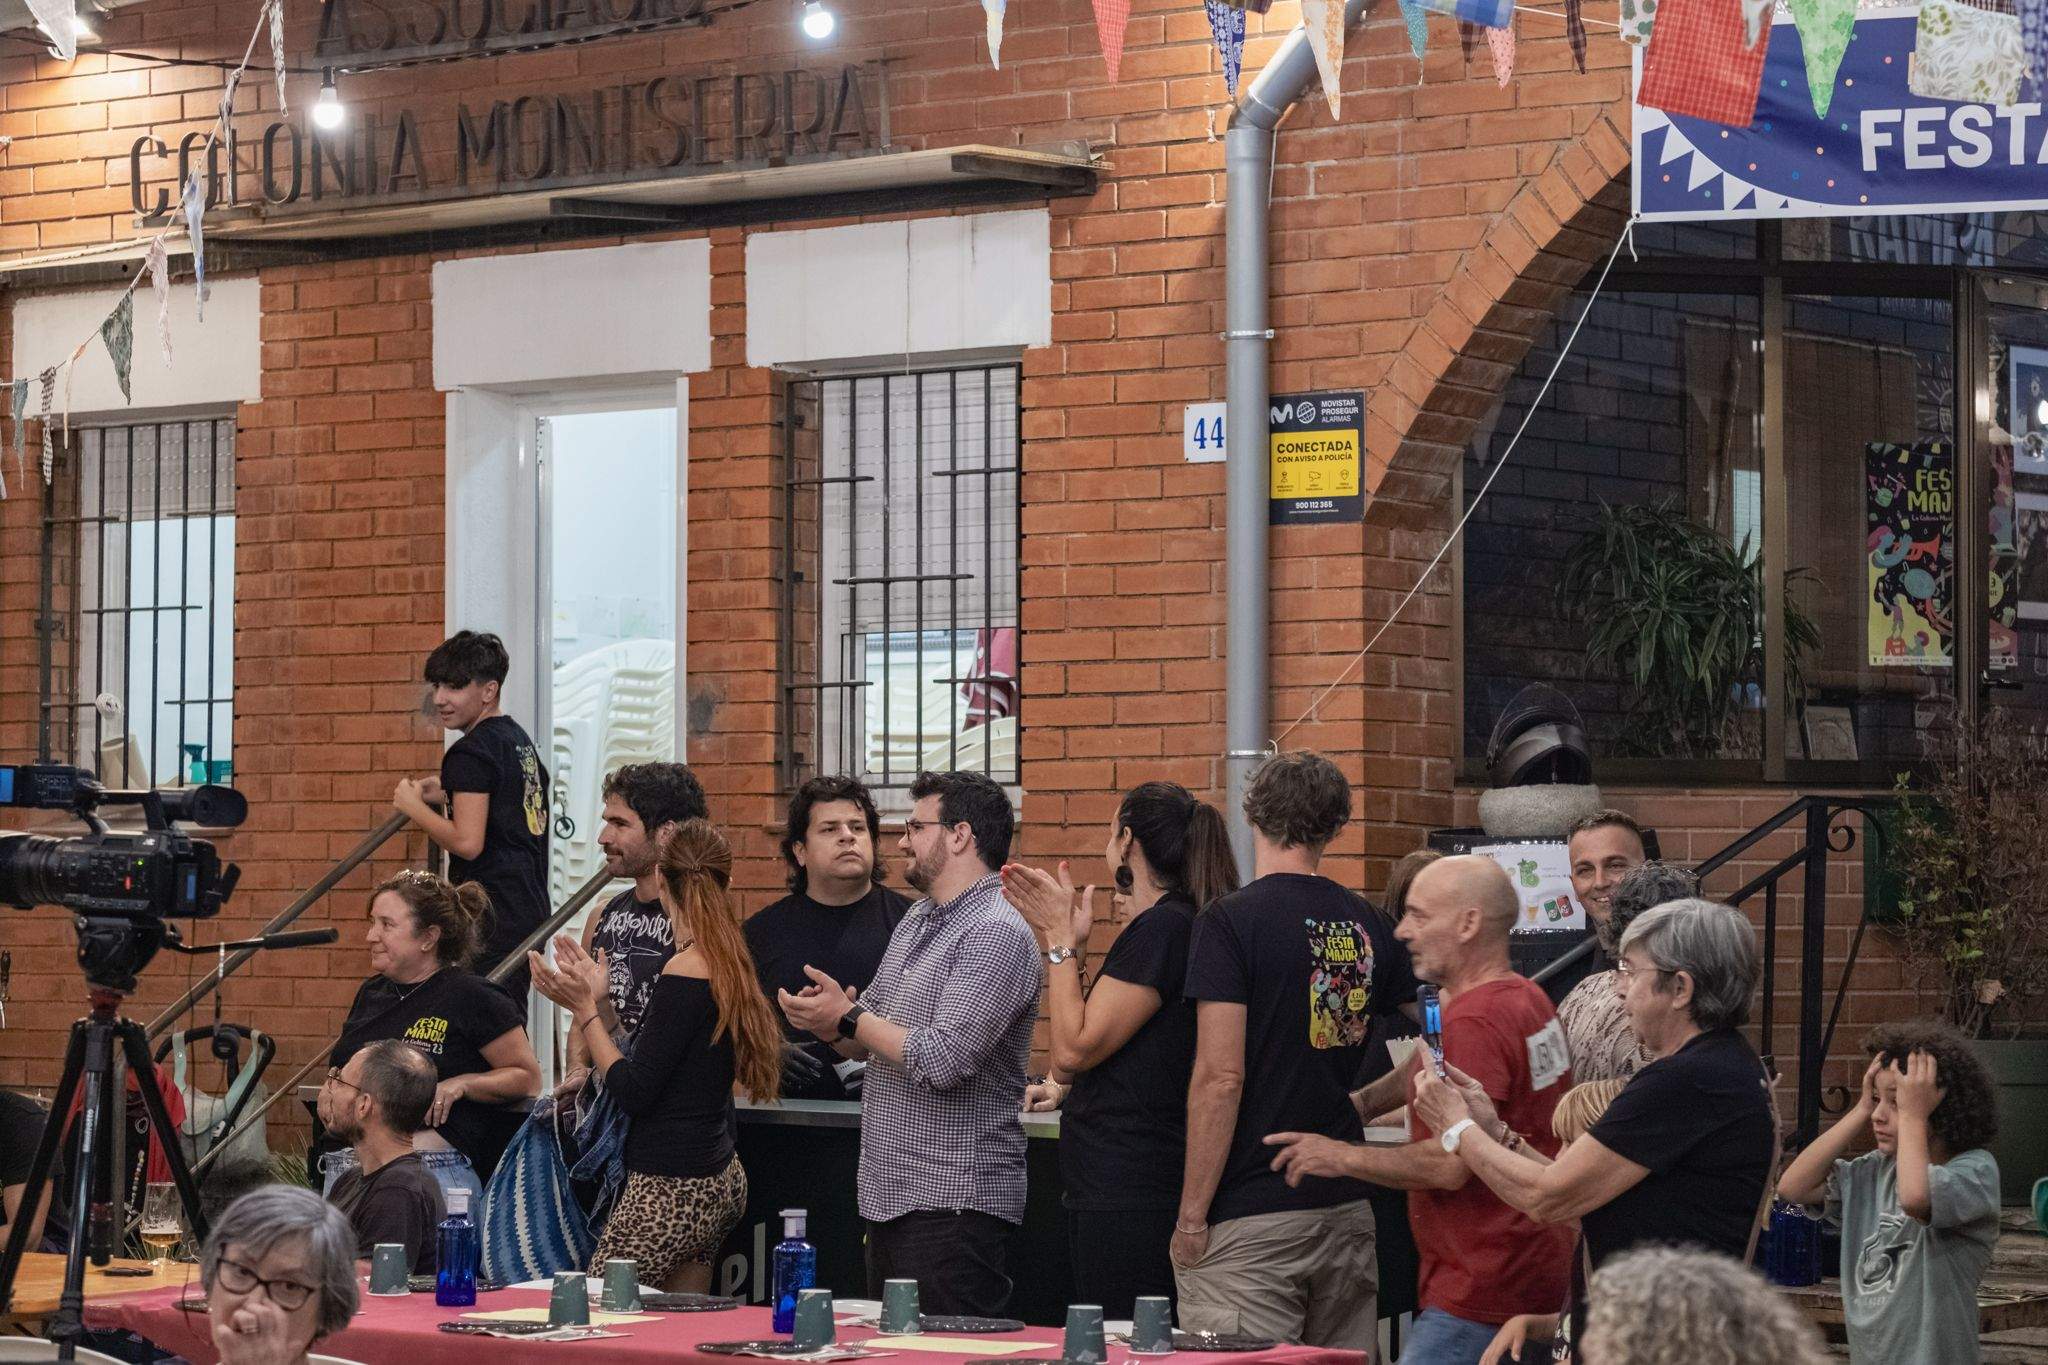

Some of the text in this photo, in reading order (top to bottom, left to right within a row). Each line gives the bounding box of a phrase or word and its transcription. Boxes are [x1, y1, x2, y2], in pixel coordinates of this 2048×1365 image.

[131, 56, 906, 218] COLONIA MONTSERRAT
[1321, 399, 1356, 408] MOVISTAR
[1321, 407, 1359, 416] PROSEGUR
[1321, 415, 1352, 423] ALARMAS
[1193, 416, 1225, 449] 44
[1277, 440, 1353, 454] CONECTADA
[1277, 452, 1353, 463] CON AVISO A POLICÍA
[1295, 501, 1309, 510] 900
[1309, 501, 1319, 509] 112
[1326, 935, 1355, 949] FESTA
[1325, 948, 1358, 962] MAJOR
[413, 1016, 448, 1033] FESTA
[404, 1027, 446, 1043] MAJOR
